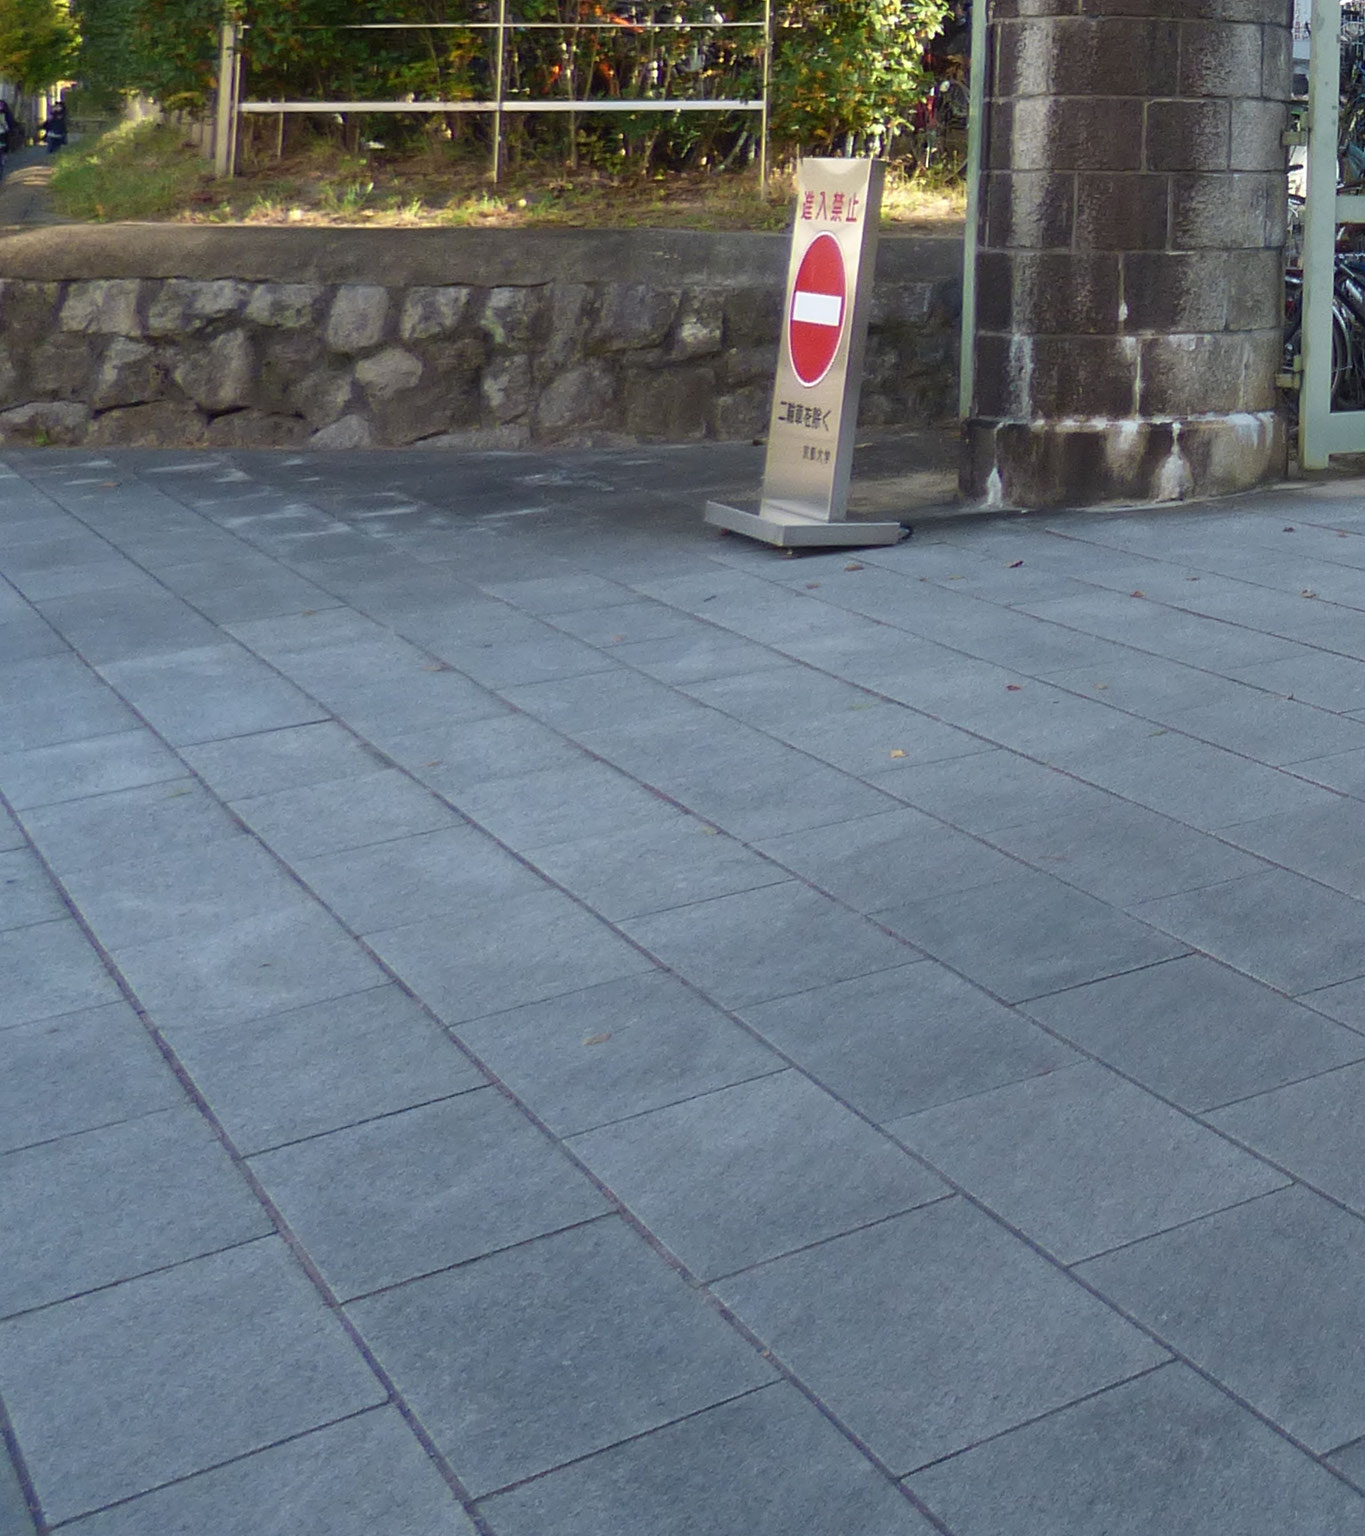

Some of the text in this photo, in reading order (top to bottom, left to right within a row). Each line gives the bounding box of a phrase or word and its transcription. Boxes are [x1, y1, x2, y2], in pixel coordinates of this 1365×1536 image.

[801, 191, 859, 222] 進入禁止
[778, 400, 831, 432] 二輪車を除く
